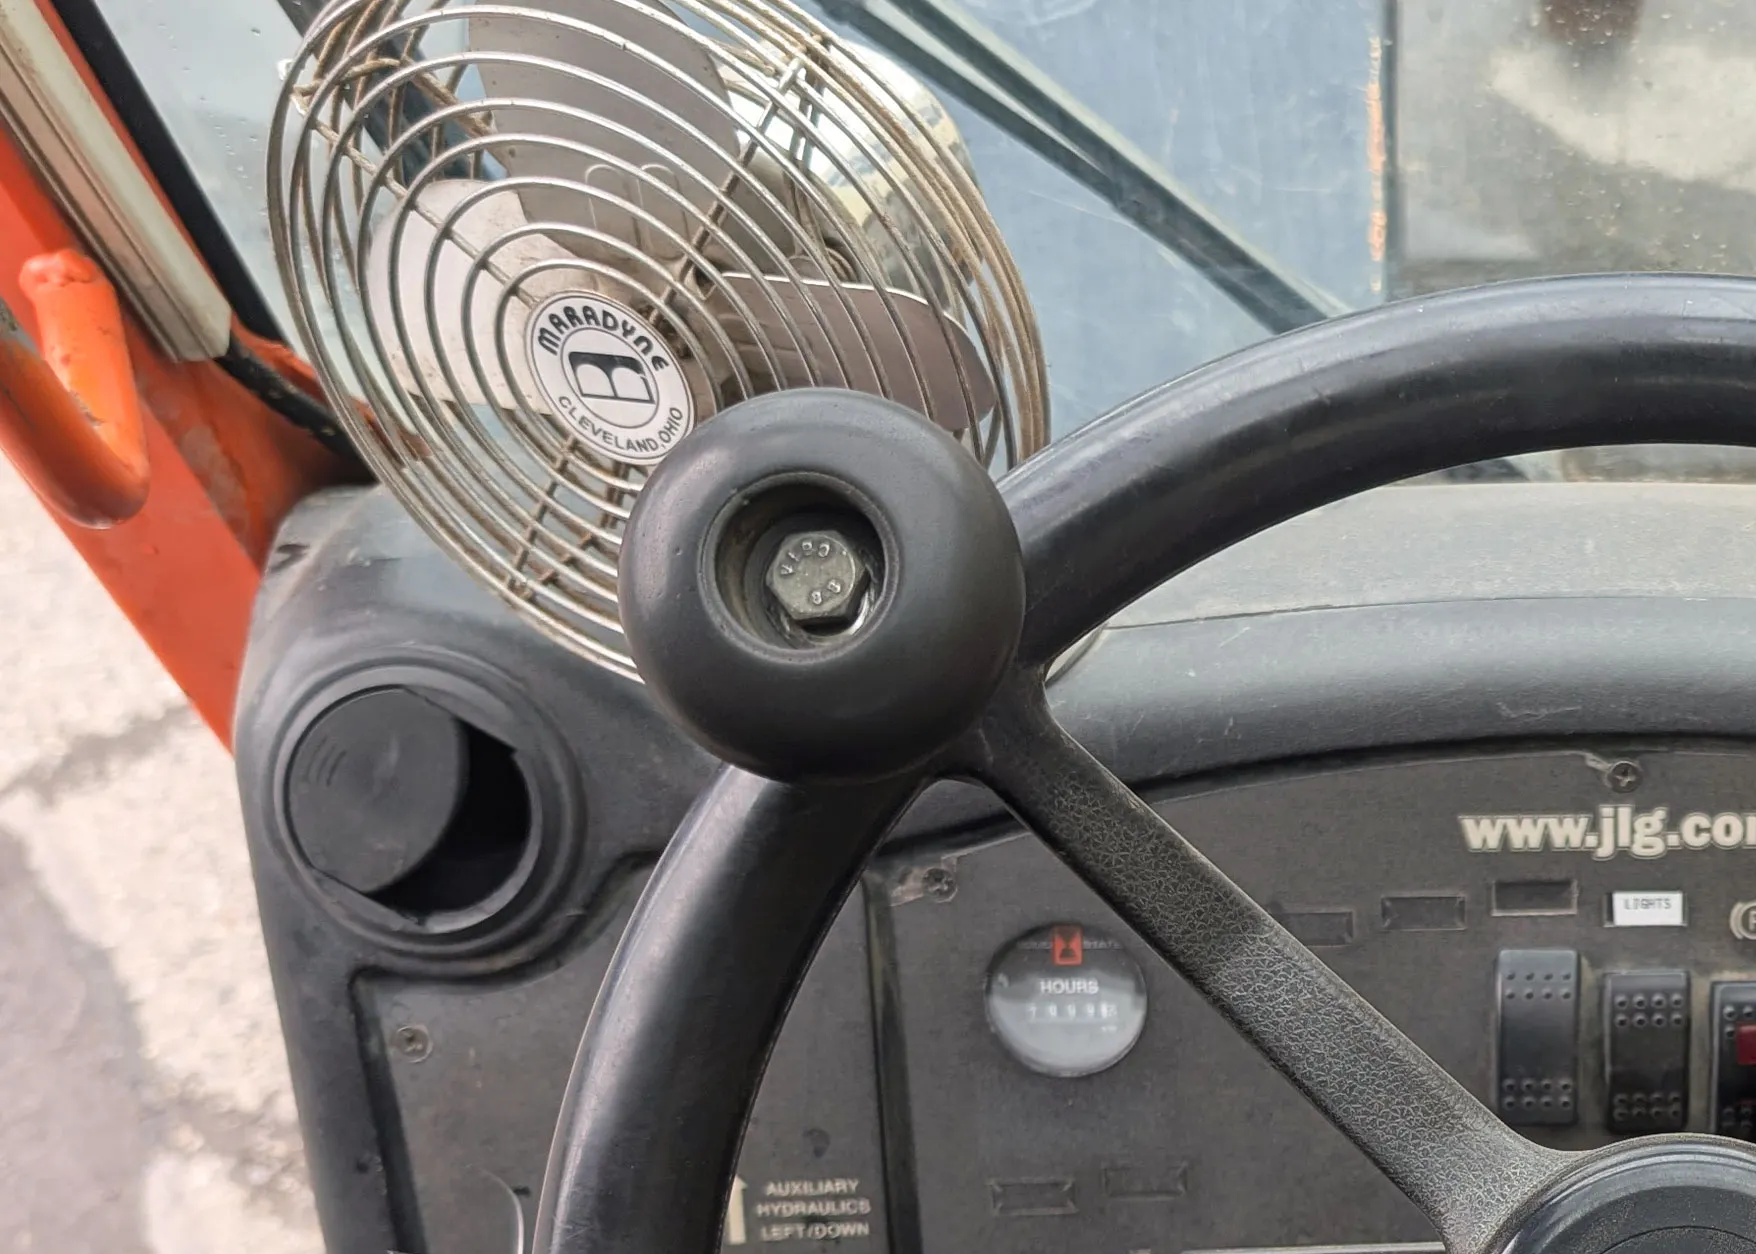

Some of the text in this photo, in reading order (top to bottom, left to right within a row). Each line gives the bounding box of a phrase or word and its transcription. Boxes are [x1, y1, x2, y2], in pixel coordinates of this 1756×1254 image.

[538, 305, 669, 373] MARADYNE
[1624, 897, 1673, 911] LIGHTS
[1039, 977, 1100, 995] HOURS
[766, 1178, 859, 1197] AUXILIARY
[756, 1198, 872, 1218] HYDRAULICS
[761, 1221, 871, 1242] LEFT/DOWN
